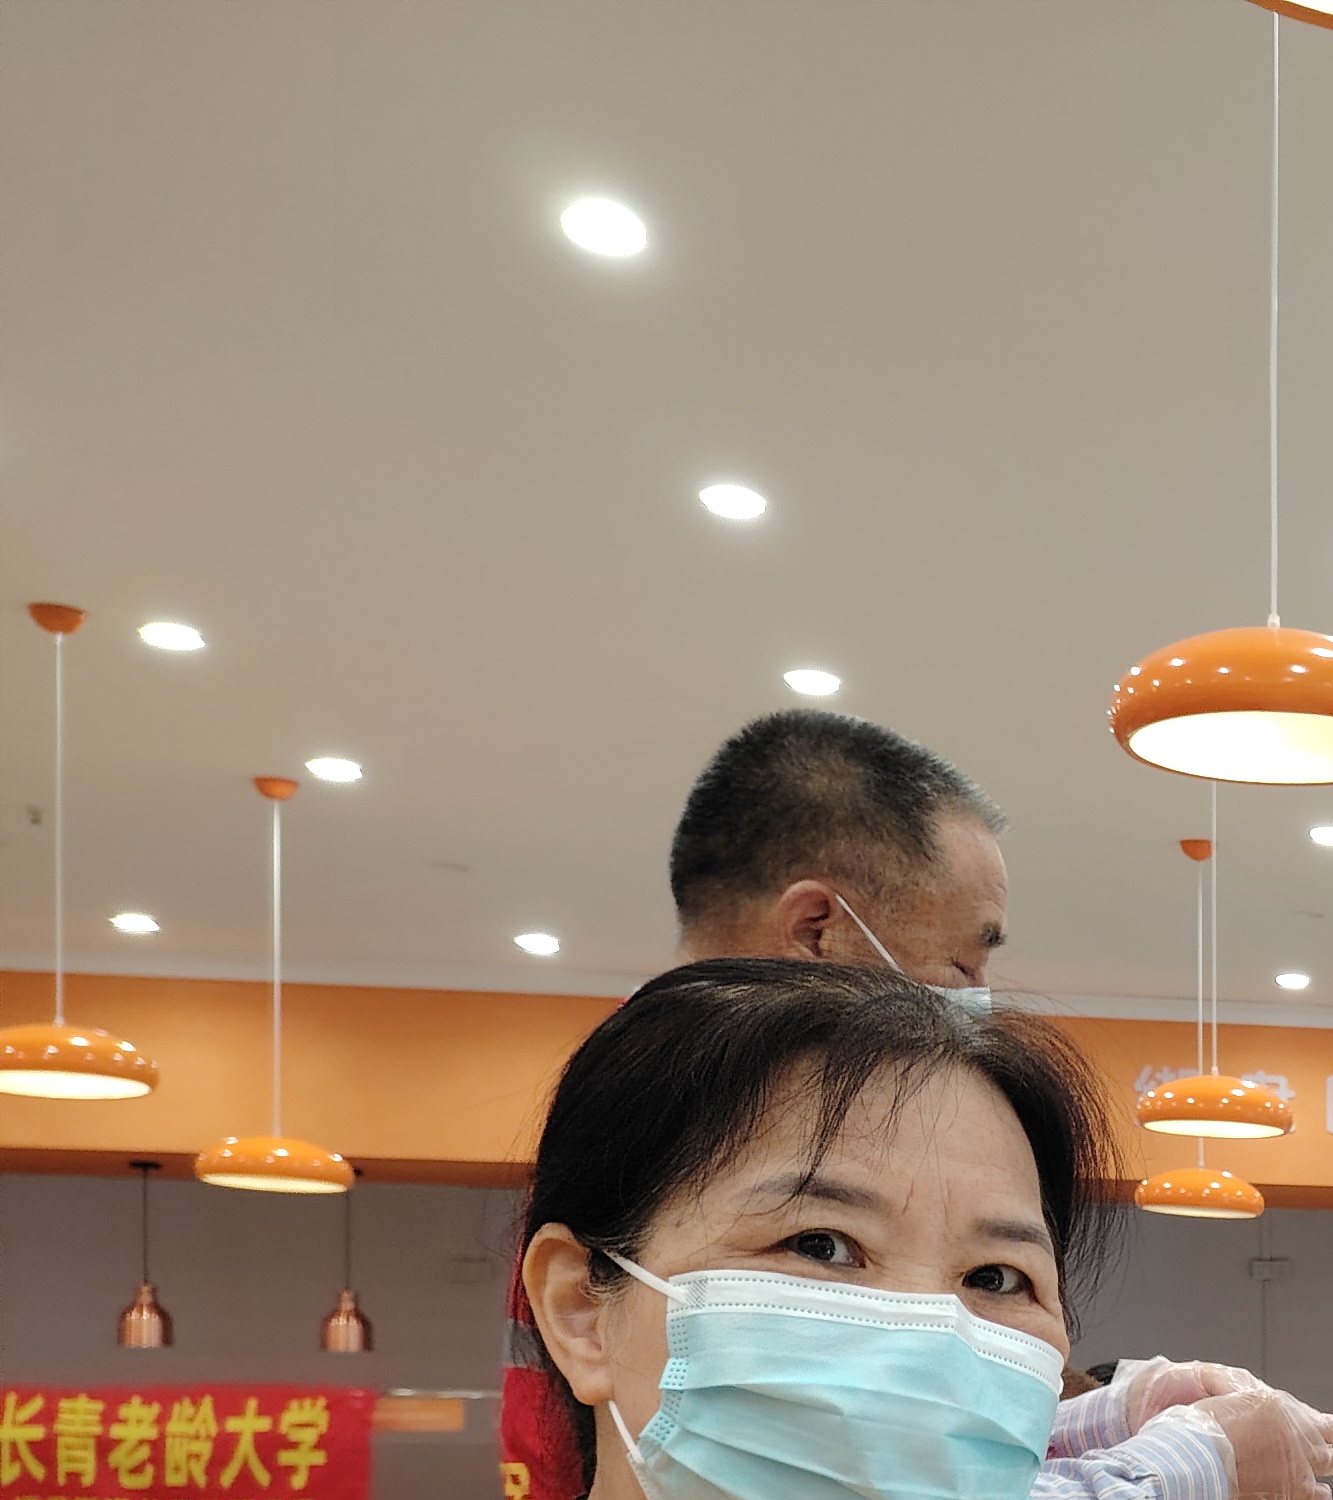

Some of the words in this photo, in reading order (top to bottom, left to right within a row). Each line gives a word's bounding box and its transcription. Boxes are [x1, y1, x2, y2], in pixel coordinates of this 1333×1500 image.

[0, 1392, 329, 1489] 长青老龄大学
